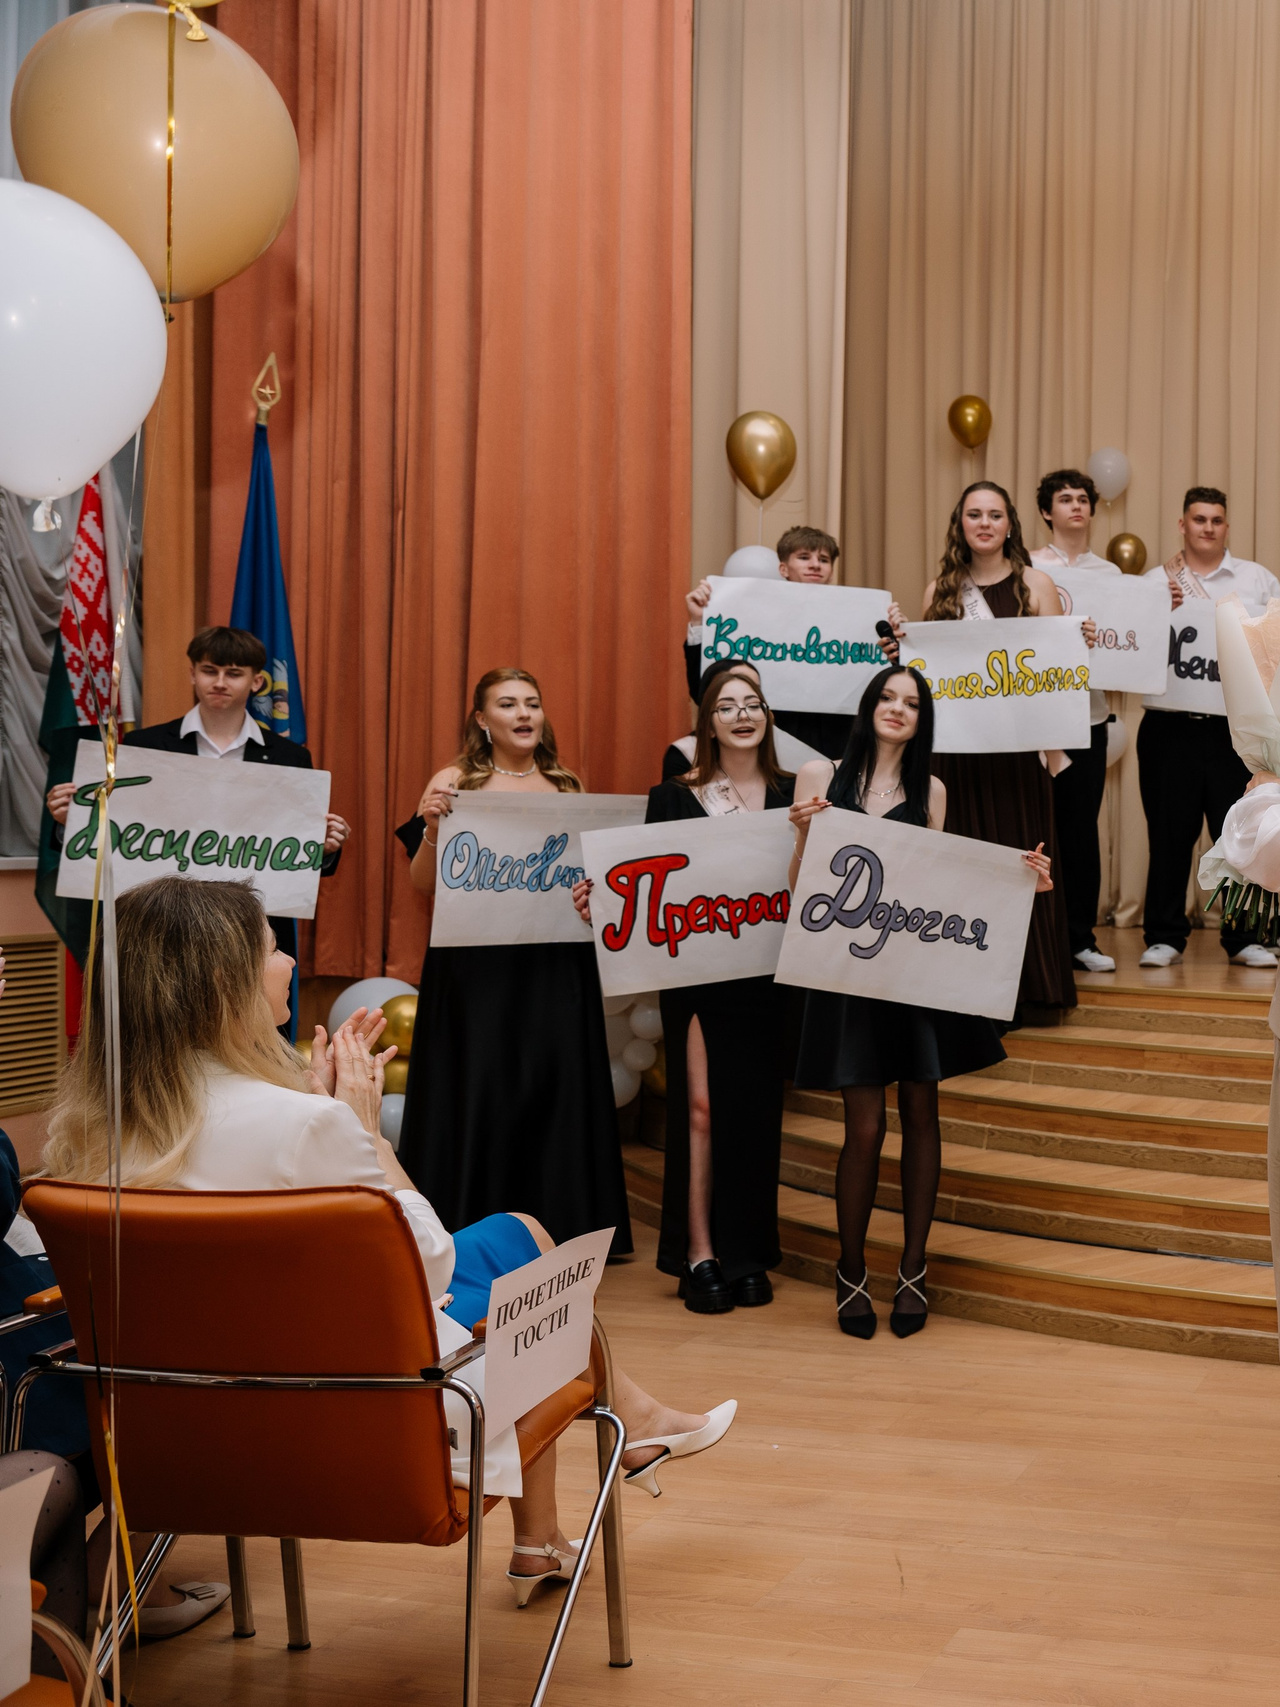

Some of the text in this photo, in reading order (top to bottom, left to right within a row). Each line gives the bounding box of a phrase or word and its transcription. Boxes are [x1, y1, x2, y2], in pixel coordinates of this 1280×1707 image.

[65, 775, 325, 872] Бесценная
[800, 844, 989, 959] Дорогая
[494, 1256, 596, 1331] ПОЧЕТНЫЕ
[513, 1302, 571, 1358] ГОСТИ
